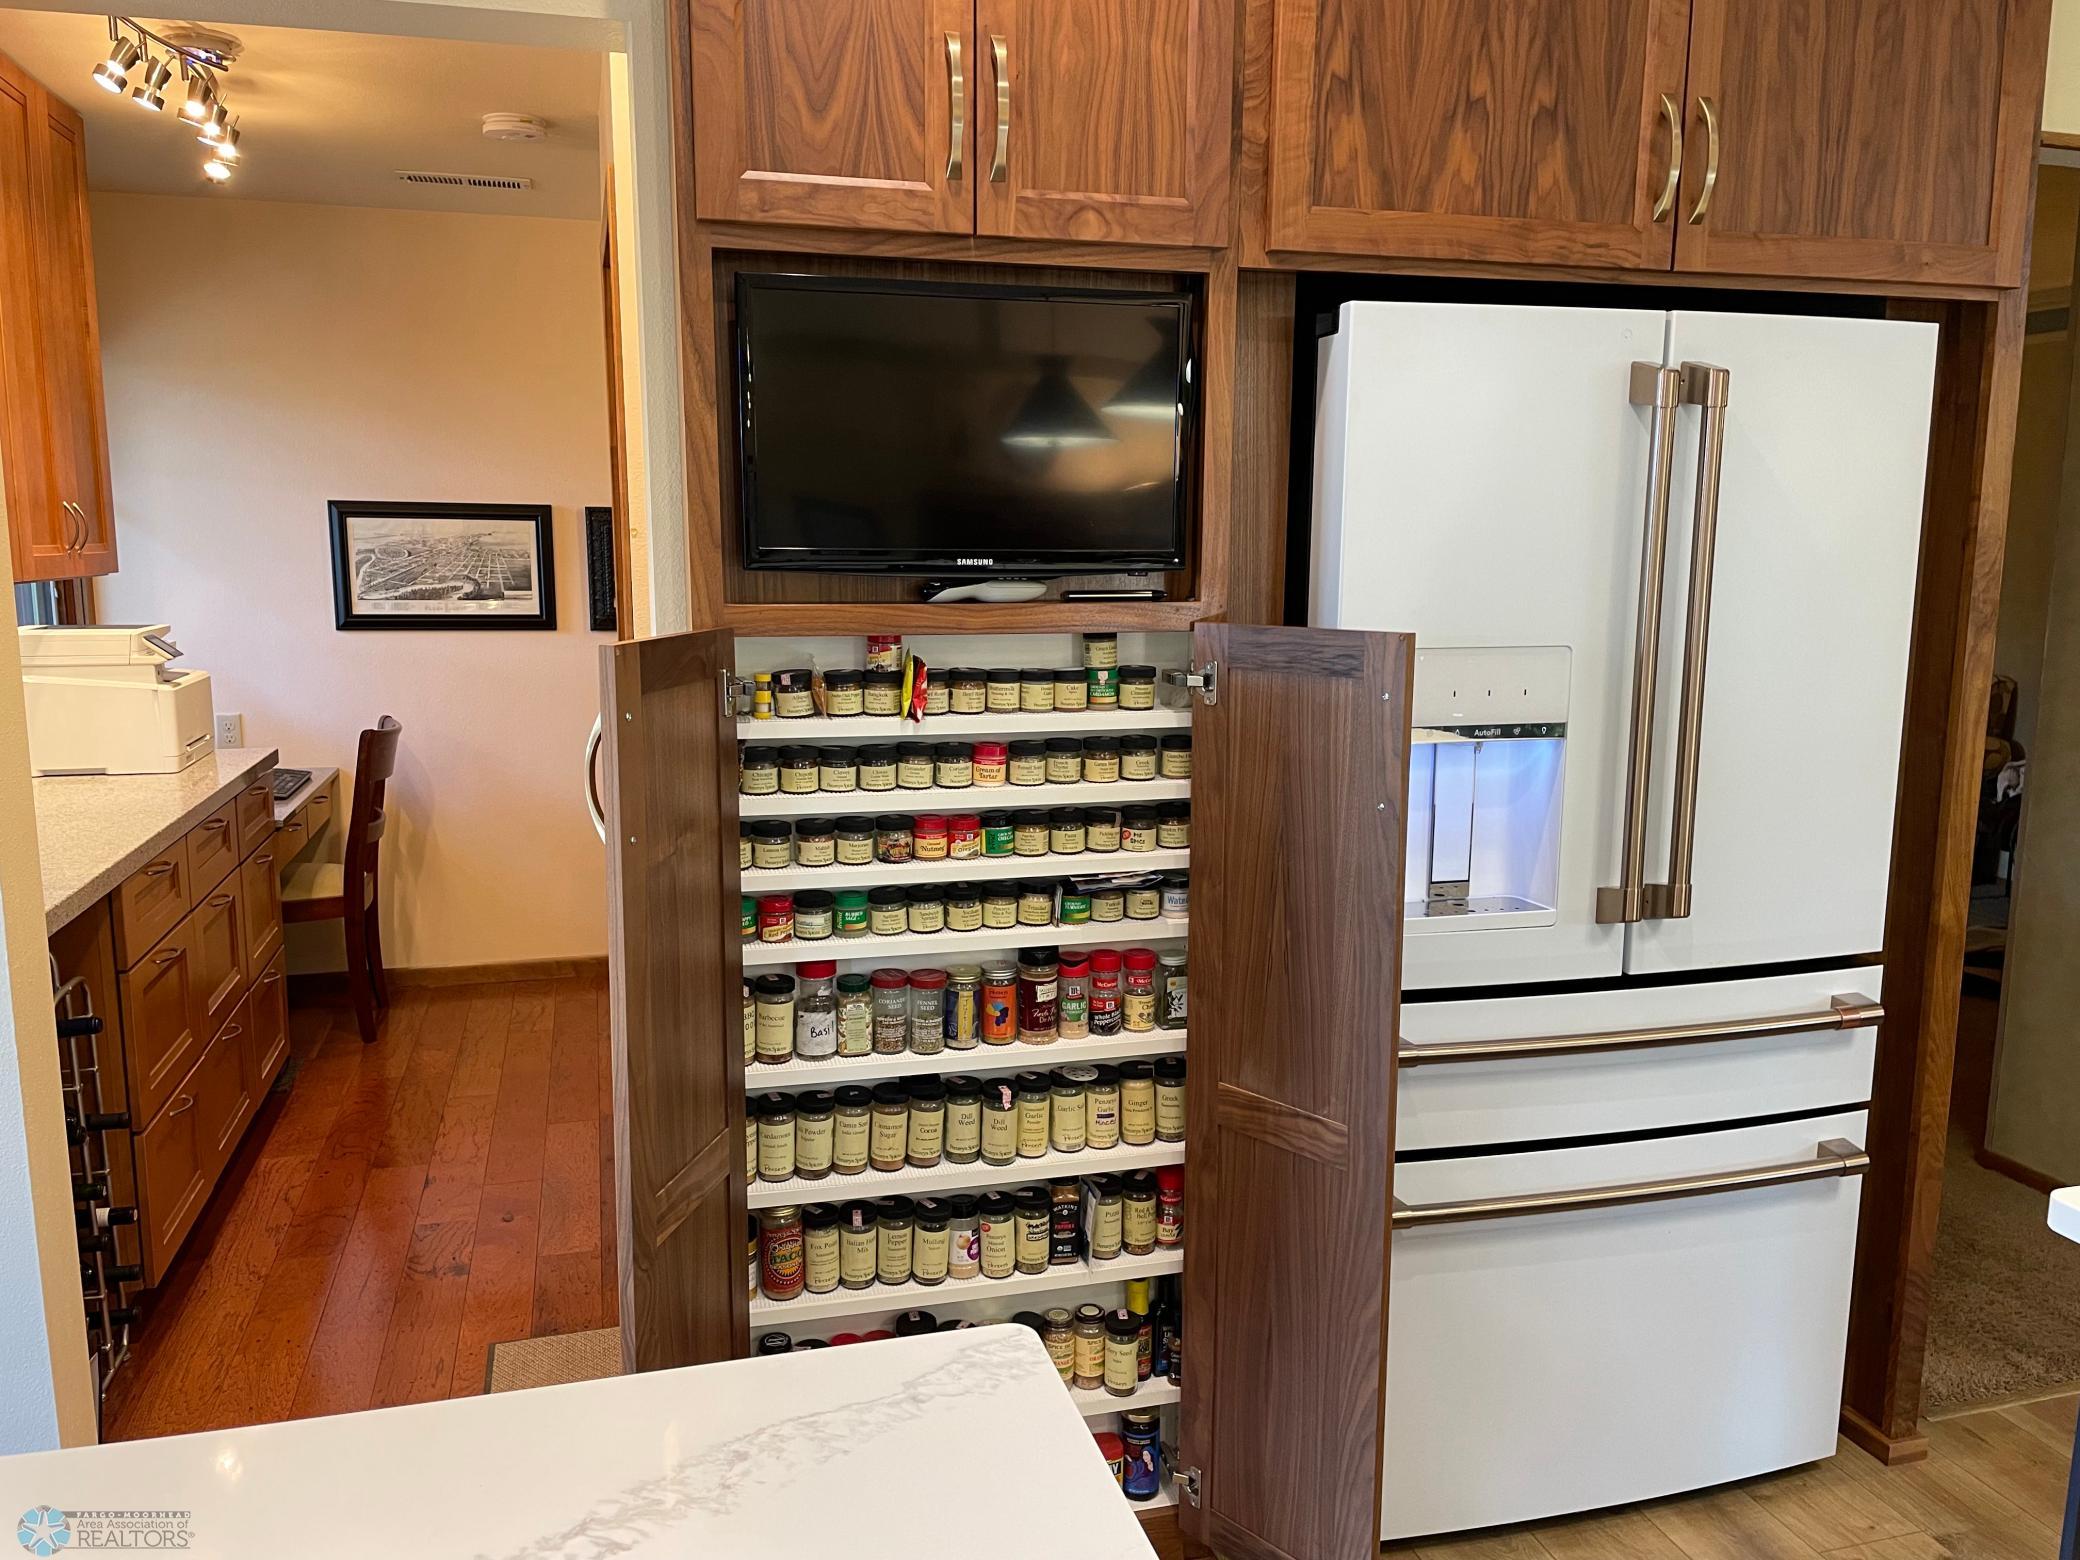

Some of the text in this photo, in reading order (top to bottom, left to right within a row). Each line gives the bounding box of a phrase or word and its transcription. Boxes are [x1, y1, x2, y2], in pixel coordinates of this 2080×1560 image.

[957, 558, 993, 566] SAMSUNG
[1473, 728, 1501, 737] AutoFill
[975, 766, 994, 774] Cream
[979, 772, 998, 780] Tartar
[921, 845, 945, 853] Nutmeg
[1061, 1001, 1087, 1010] GARLIC
[810, 1020, 834, 1038] Basil
[1128, 1099, 1149, 1108] Ginger
[960, 1113, 973, 1121] Dill
[993, 1117, 1005, 1125] Dill
[957, 1119, 976, 1127] Weed
[990, 1123, 1008, 1131] Weed
[919, 1127, 938, 1135] Cocoa
[1053, 1204, 1078, 1212] WATKINS
[986, 1246, 1006, 1254] Onion
[1048, 1342, 1066, 1350] SPICE
